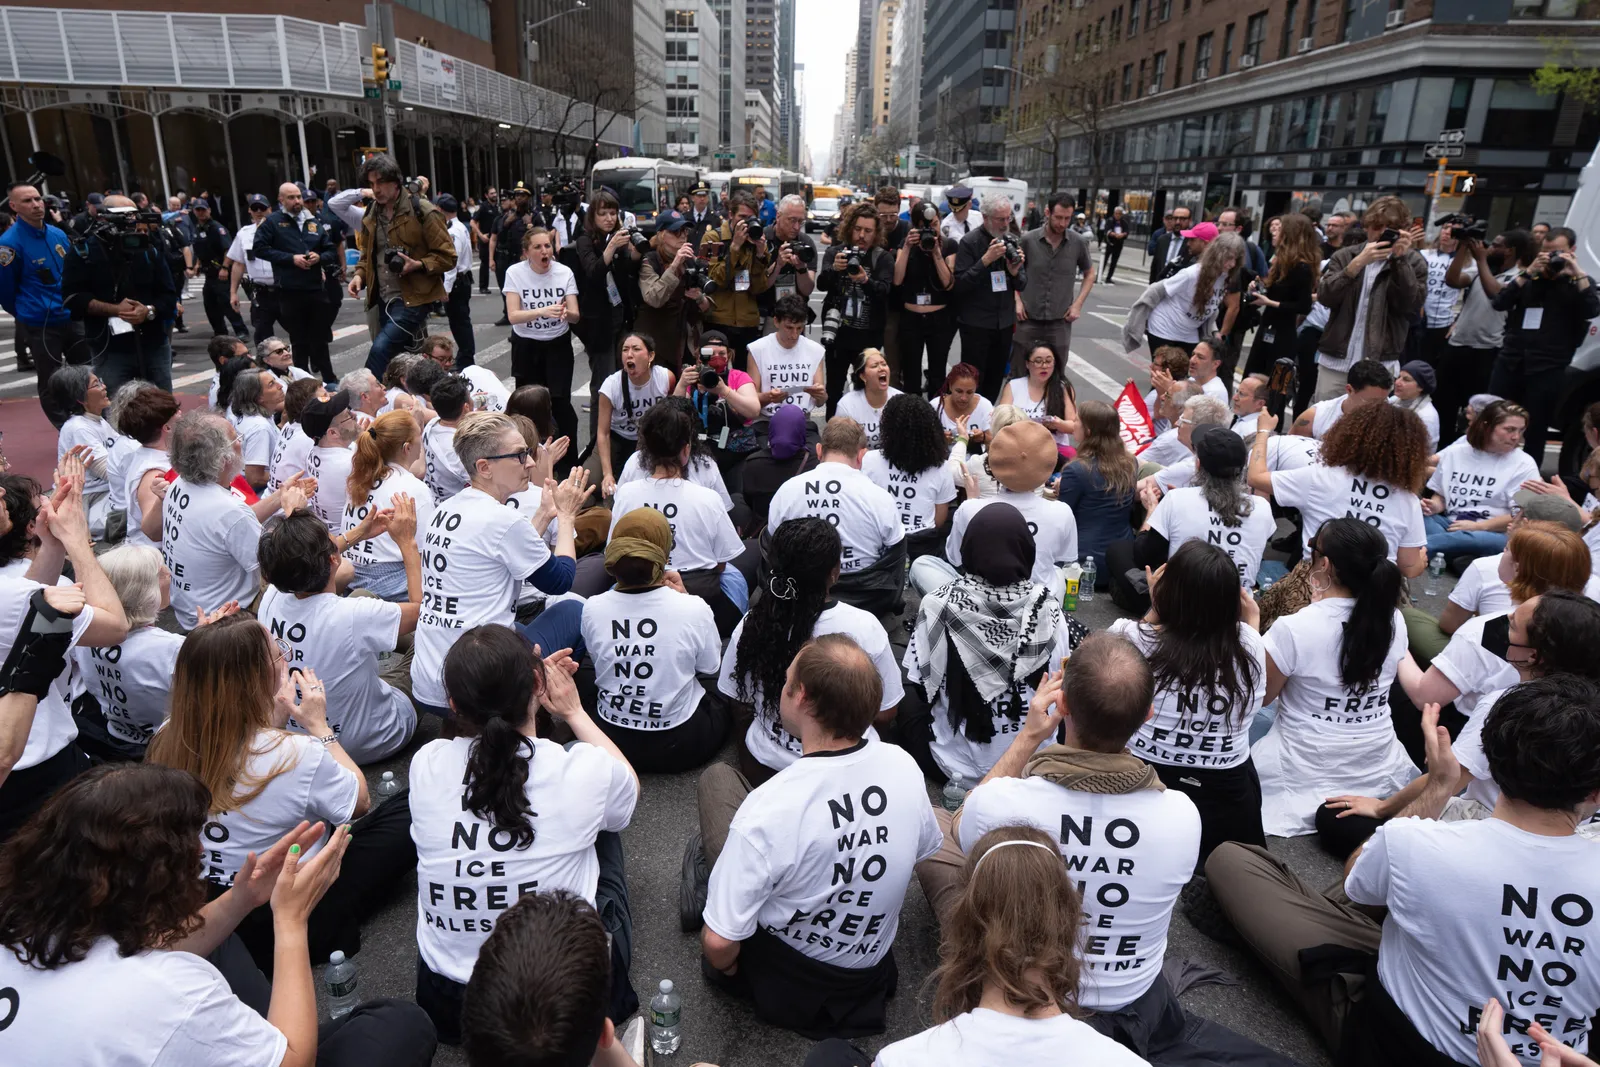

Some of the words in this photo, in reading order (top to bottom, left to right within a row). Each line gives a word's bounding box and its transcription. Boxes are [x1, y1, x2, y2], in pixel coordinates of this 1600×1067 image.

[522, 287, 566, 299] FUND
[770, 372, 809, 383] FUND
[786, 395, 803, 405] OT
[805, 480, 842, 495] NO
[889, 473, 918, 484] WAR
[1351, 478, 1390, 500] NO
[1451, 471, 1497, 486] FUND
[170, 484, 190, 510] NO
[888, 484, 916, 499] NO
[167, 504, 183, 524] WAR
[345, 503, 369, 520] NO
[807, 499, 840, 509] WAR
[1350, 497, 1385, 514] WAR
[164, 517, 179, 541] NO
[431, 510, 462, 532] NO
[426, 532, 452, 549] WAR
[1208, 530, 1242, 545] NO
[422, 549, 447, 573] NO
[270, 617, 307, 643] NO
[611, 618, 658, 640] NO
[91, 645, 122, 664] NO
[615, 645, 655, 657] WAR
[95, 664, 122, 682] WAR
[614, 662, 654, 681] NO
[100, 680, 127, 704] NO
[109, 704, 131, 720] ICE
[1176, 693, 1230, 715] NO
[1180, 719, 1220, 733] ICE
[1151, 727, 1233, 752] FREE
[1135, 738, 1240, 765] PALESTINE
[827, 785, 888, 829] NO
[204, 822, 230, 843] O
[452, 821, 520, 852] NO
[837, 825, 889, 852] WAR
[1060, 814, 1140, 849] NO
[455, 859, 506, 877] ICE
[831, 854, 887, 886] NO
[1063, 854, 1135, 876] WAR
[826, 890, 873, 907] ICE
[1501, 883, 1594, 927] NO
[425, 911, 493, 933] PALES
[786, 908, 886, 937] FREE
[766, 924, 881, 955] PALESTINE
[1503, 926, 1586, 957] WAR
[1497, 954, 1577, 987] NO
[1506, 990, 1564, 1010] ICE
